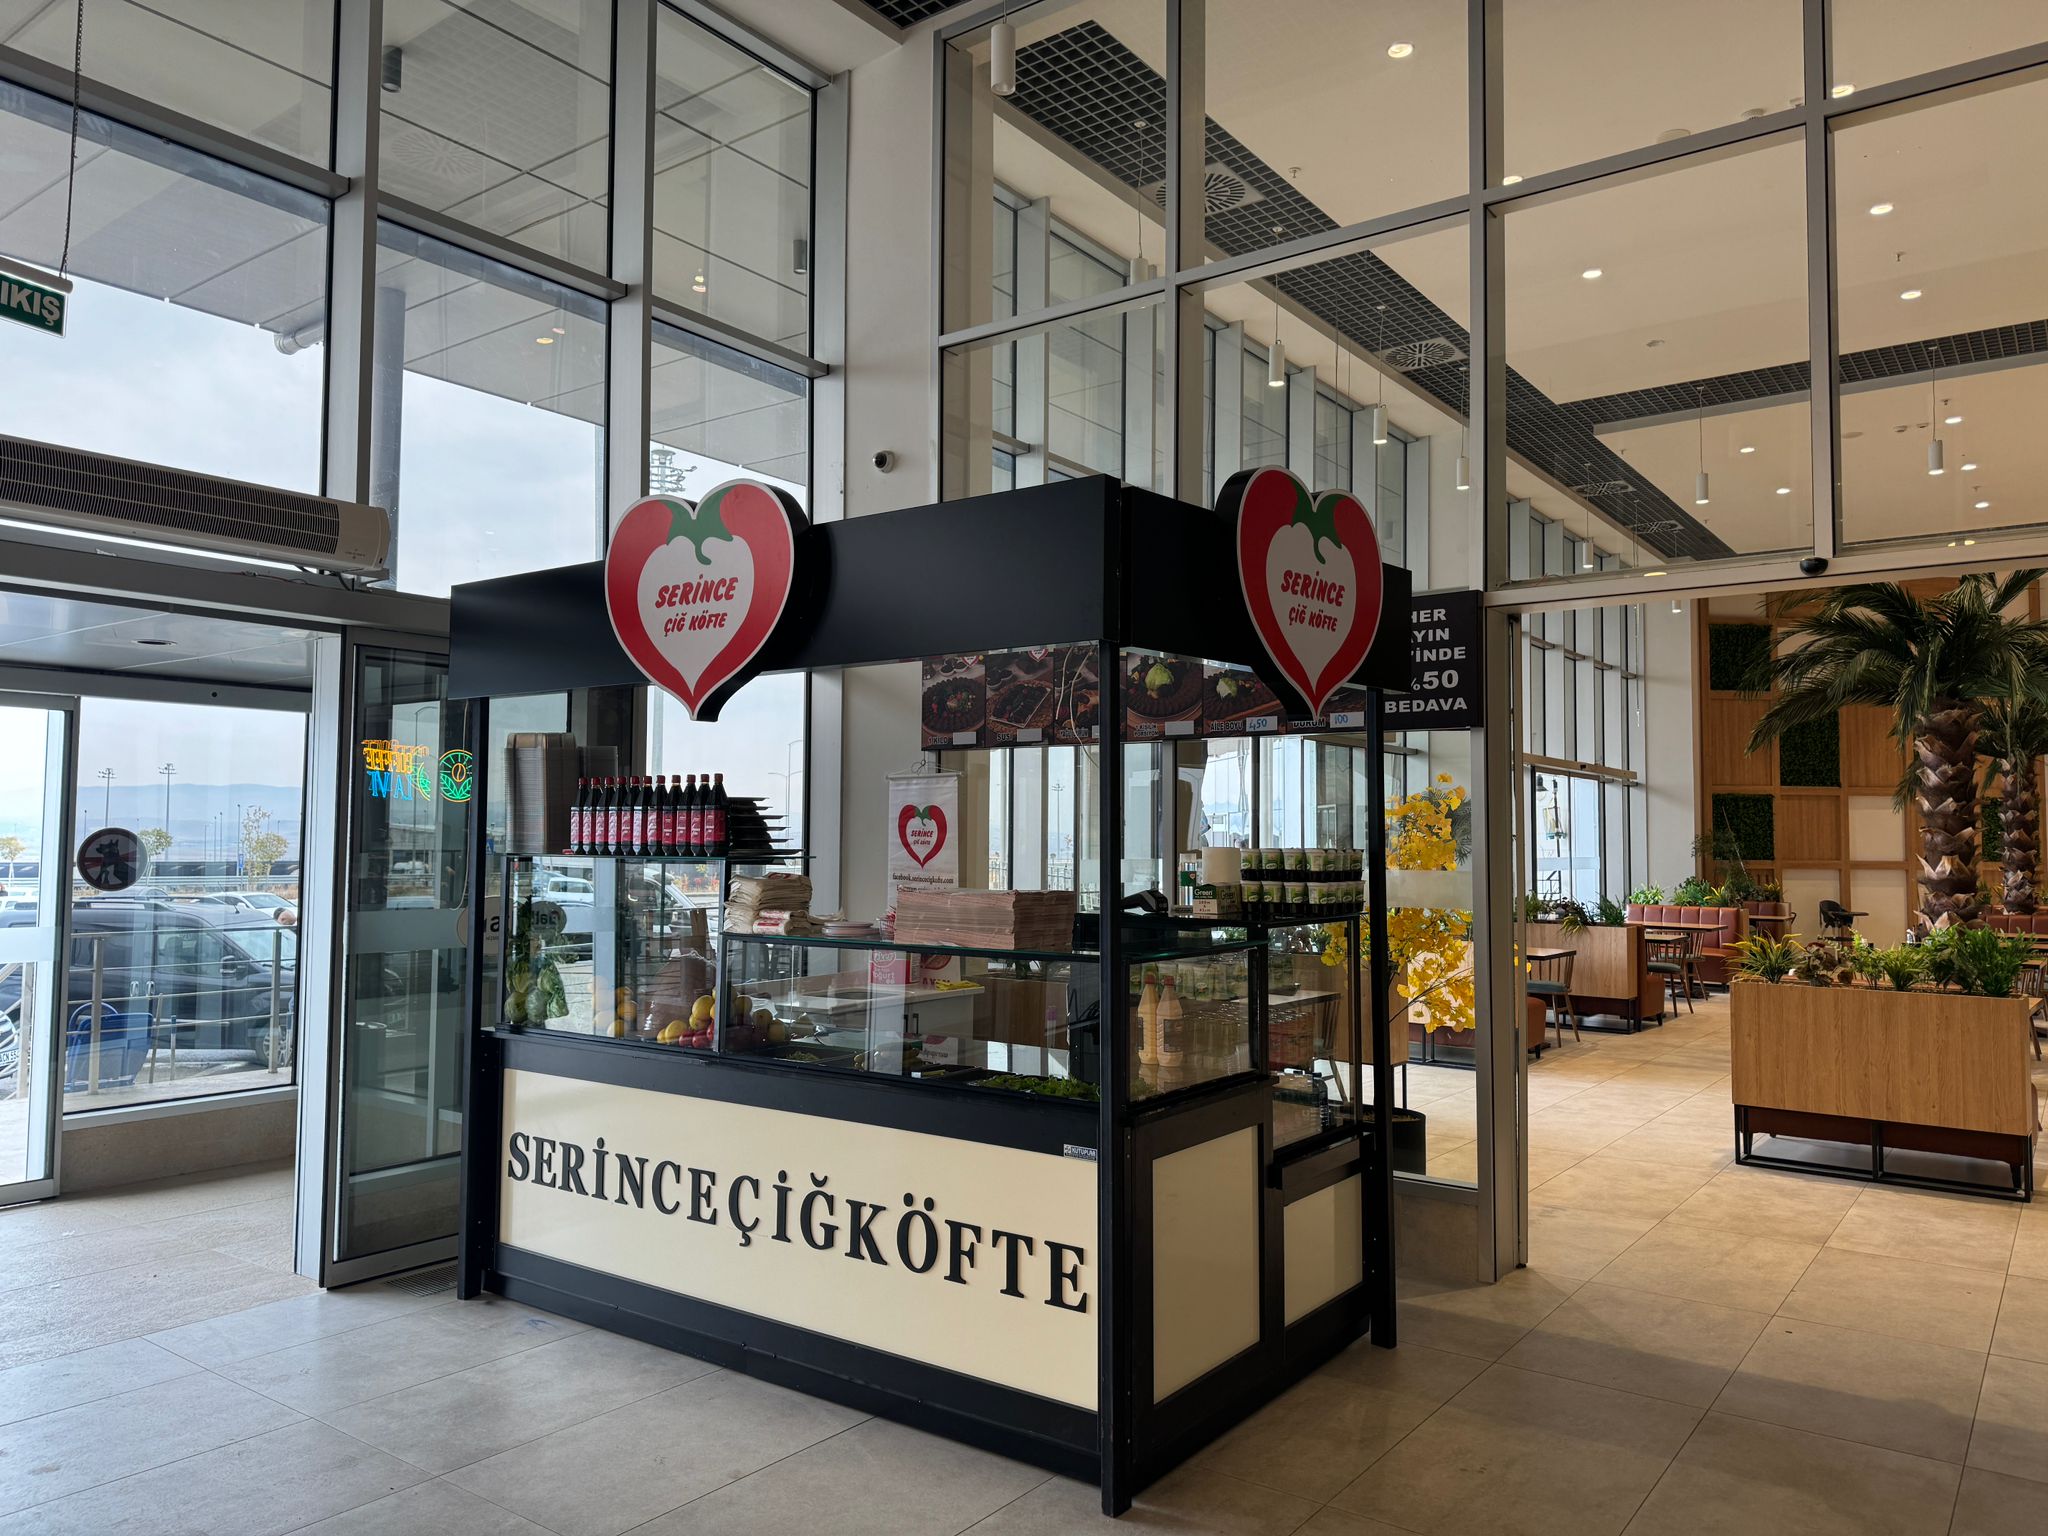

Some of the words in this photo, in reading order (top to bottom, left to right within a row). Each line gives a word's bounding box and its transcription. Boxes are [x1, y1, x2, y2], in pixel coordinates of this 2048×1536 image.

[655, 574, 739, 609] SERİNCE
[1280, 569, 1345, 607] SERİNCE
[663, 612, 686, 637] ÇİĞ
[688, 609, 728, 632] KÖFTE
[1288, 603, 1307, 626] ÇİĞ
[1308, 609, 1338, 632] KÖFTE
[1411, 627, 1450, 643] YIN
[1384, 697, 1468, 713] BEDAVA
